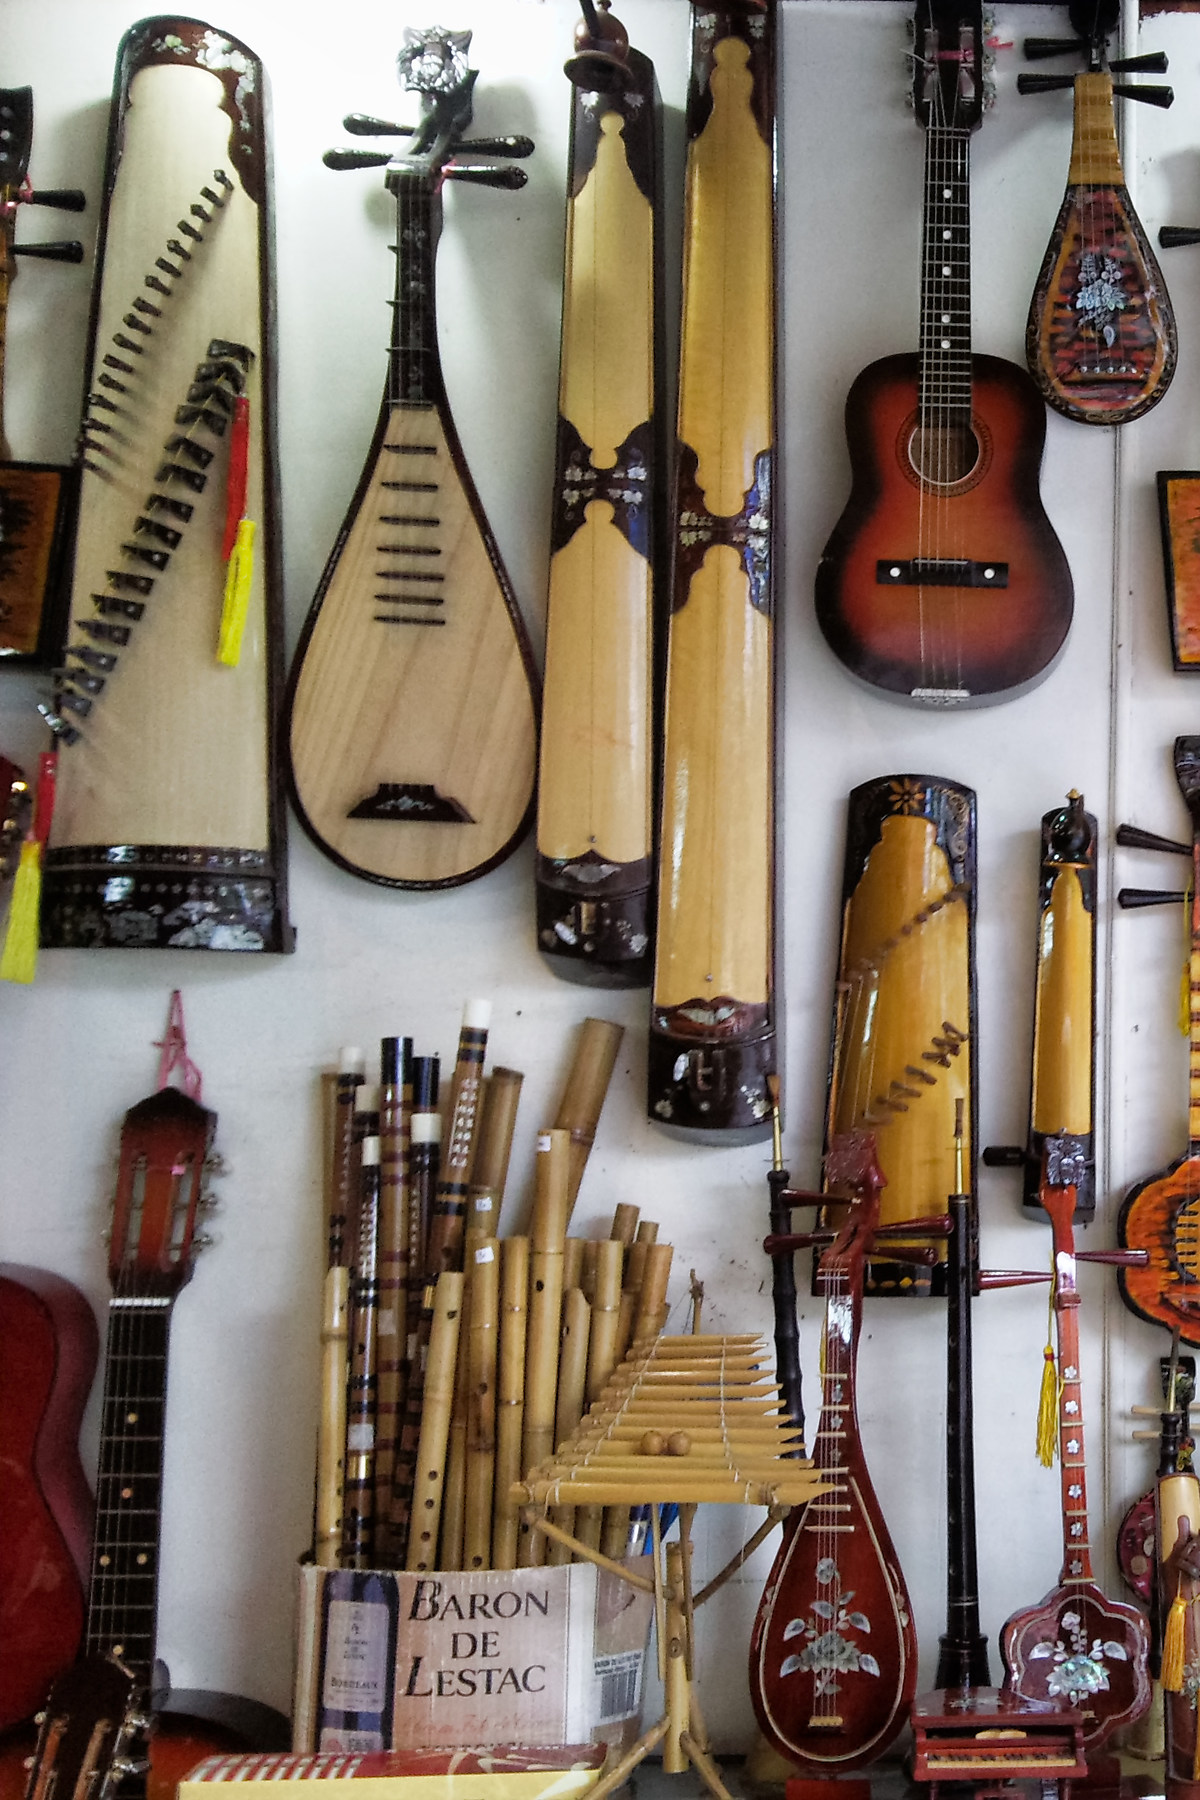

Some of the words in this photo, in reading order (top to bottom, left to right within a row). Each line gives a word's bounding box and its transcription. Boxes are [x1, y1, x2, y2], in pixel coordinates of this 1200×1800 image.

[408, 1580, 549, 1621] BARON
[451, 1631, 501, 1659] DE
[404, 1656, 546, 1697] LESTAC
